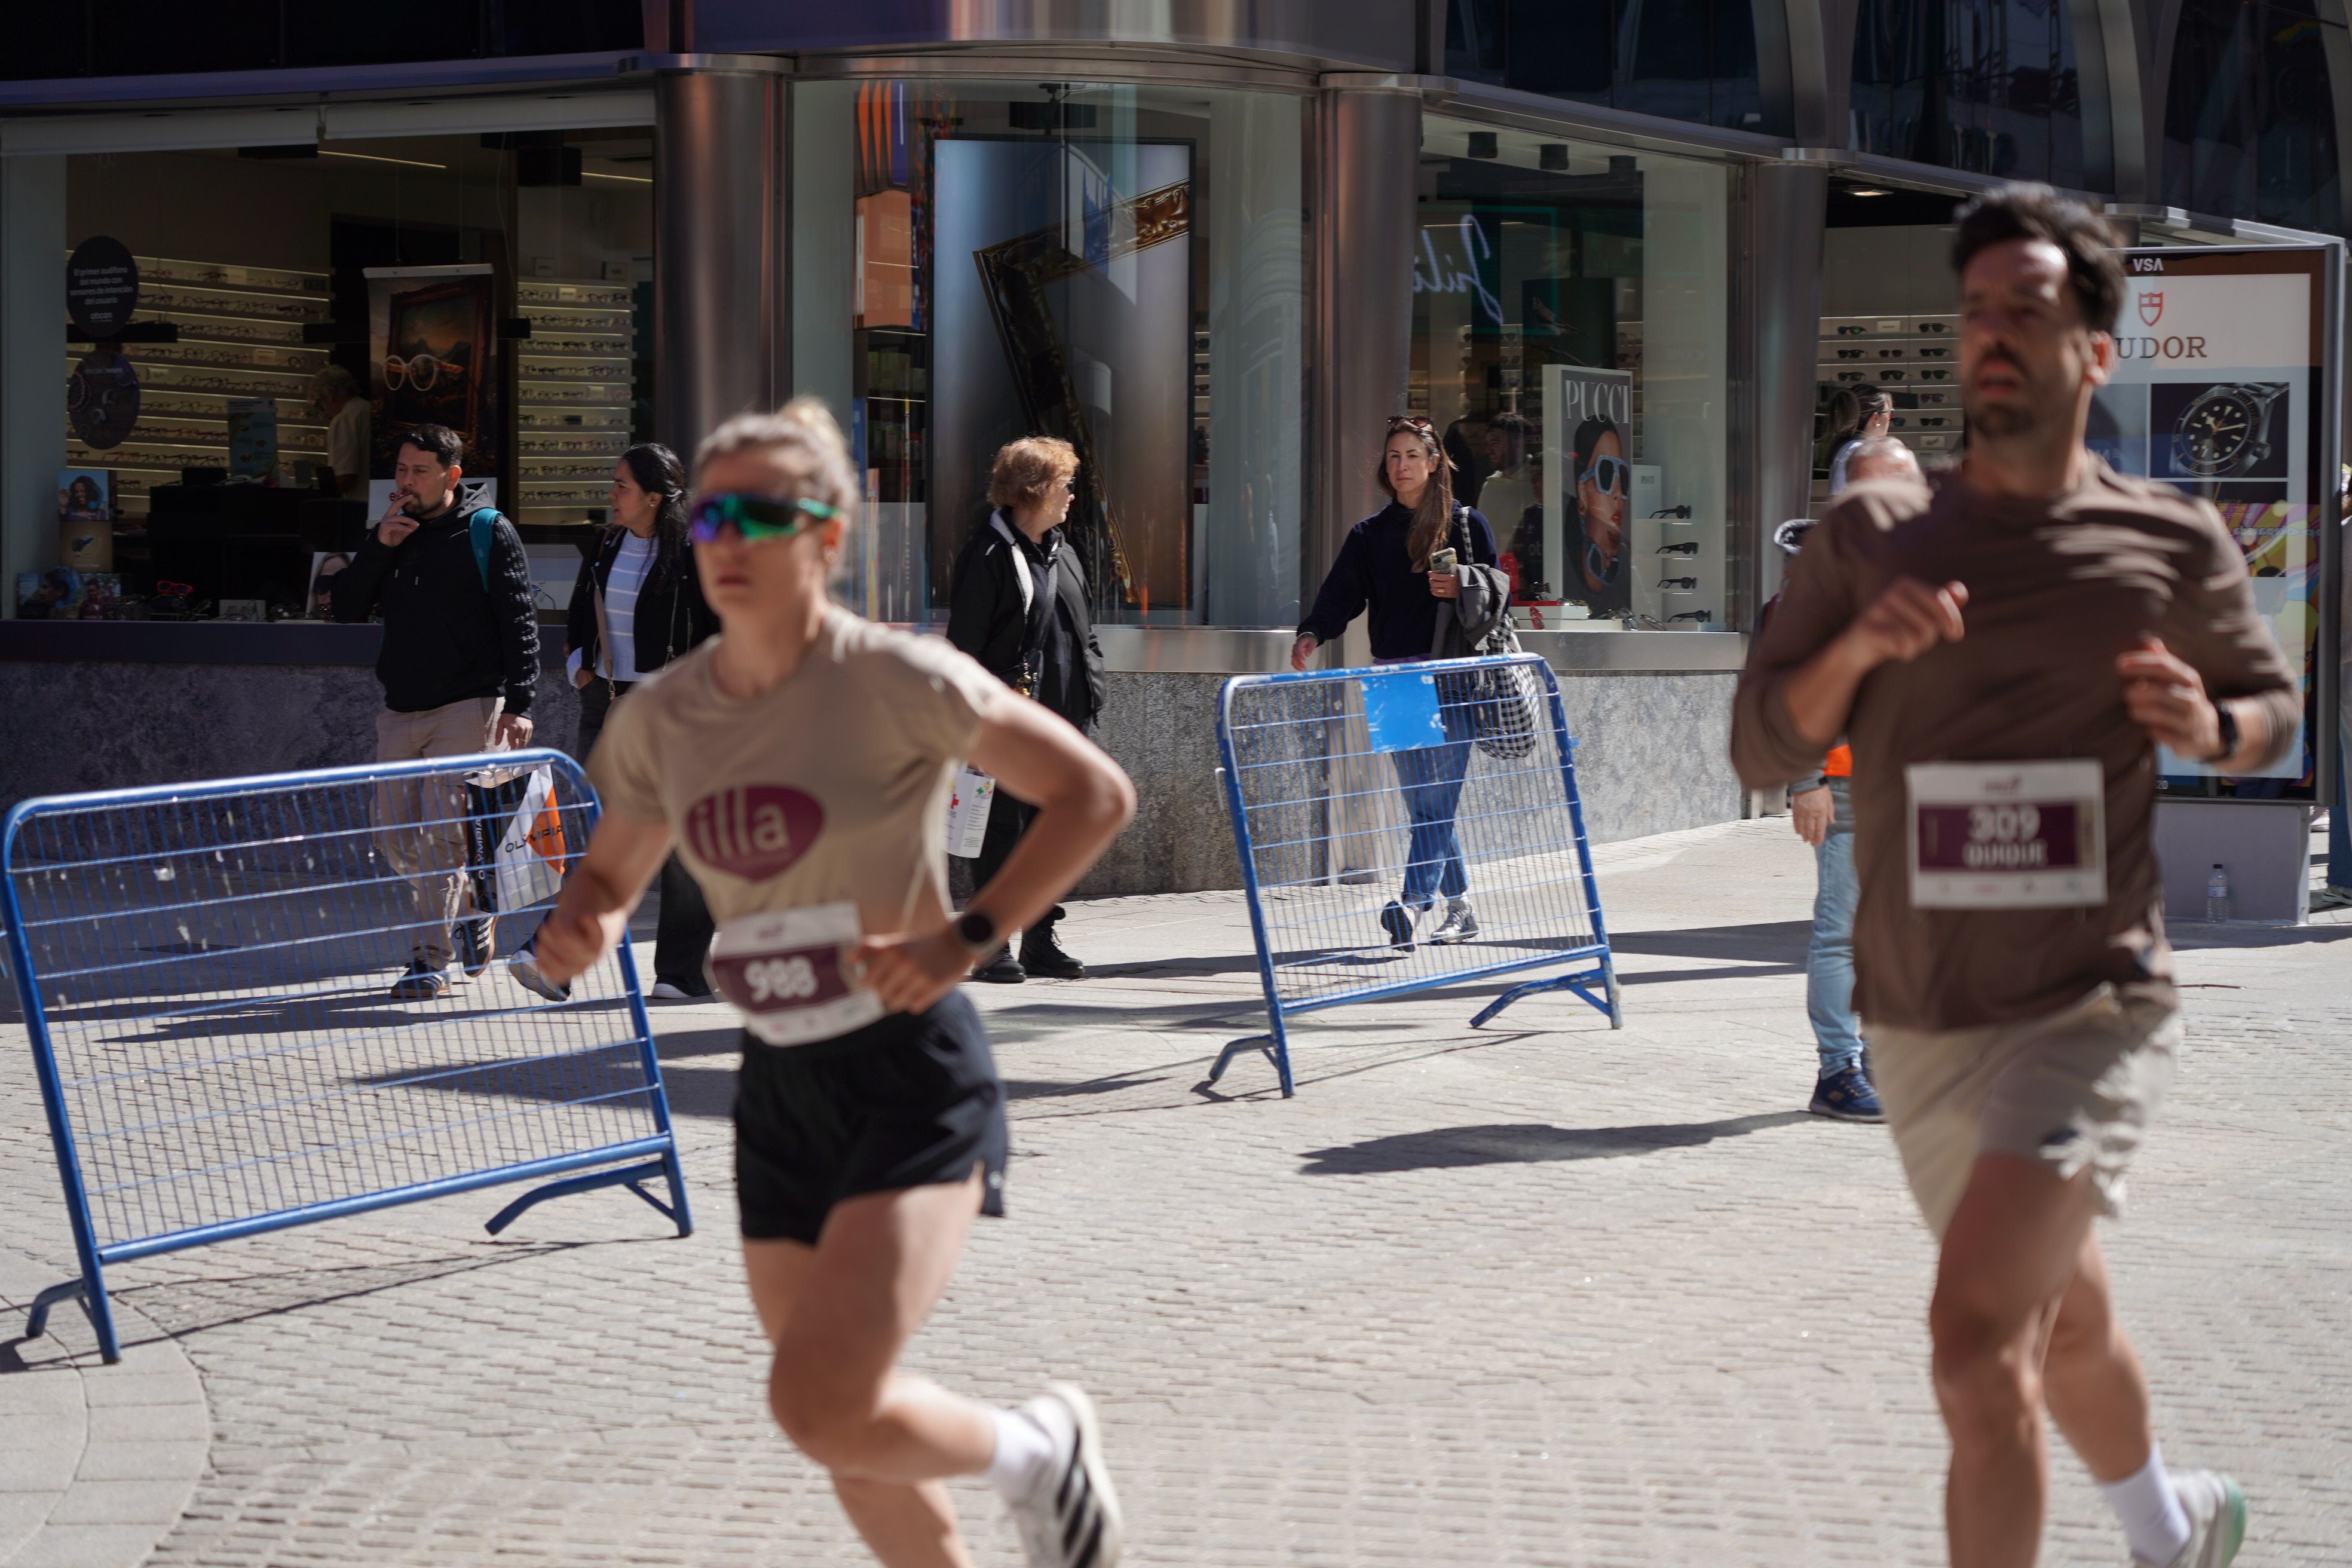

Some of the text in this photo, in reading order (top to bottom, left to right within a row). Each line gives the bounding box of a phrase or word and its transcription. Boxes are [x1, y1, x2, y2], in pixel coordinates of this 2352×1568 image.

[2132, 258, 2164, 272] VSA
[2113, 336, 2207, 359] UDOR
[1563, 380, 1631, 424] PUCCI
[1967, 803, 2041, 843] 309
[743, 955, 819, 1004] 988
